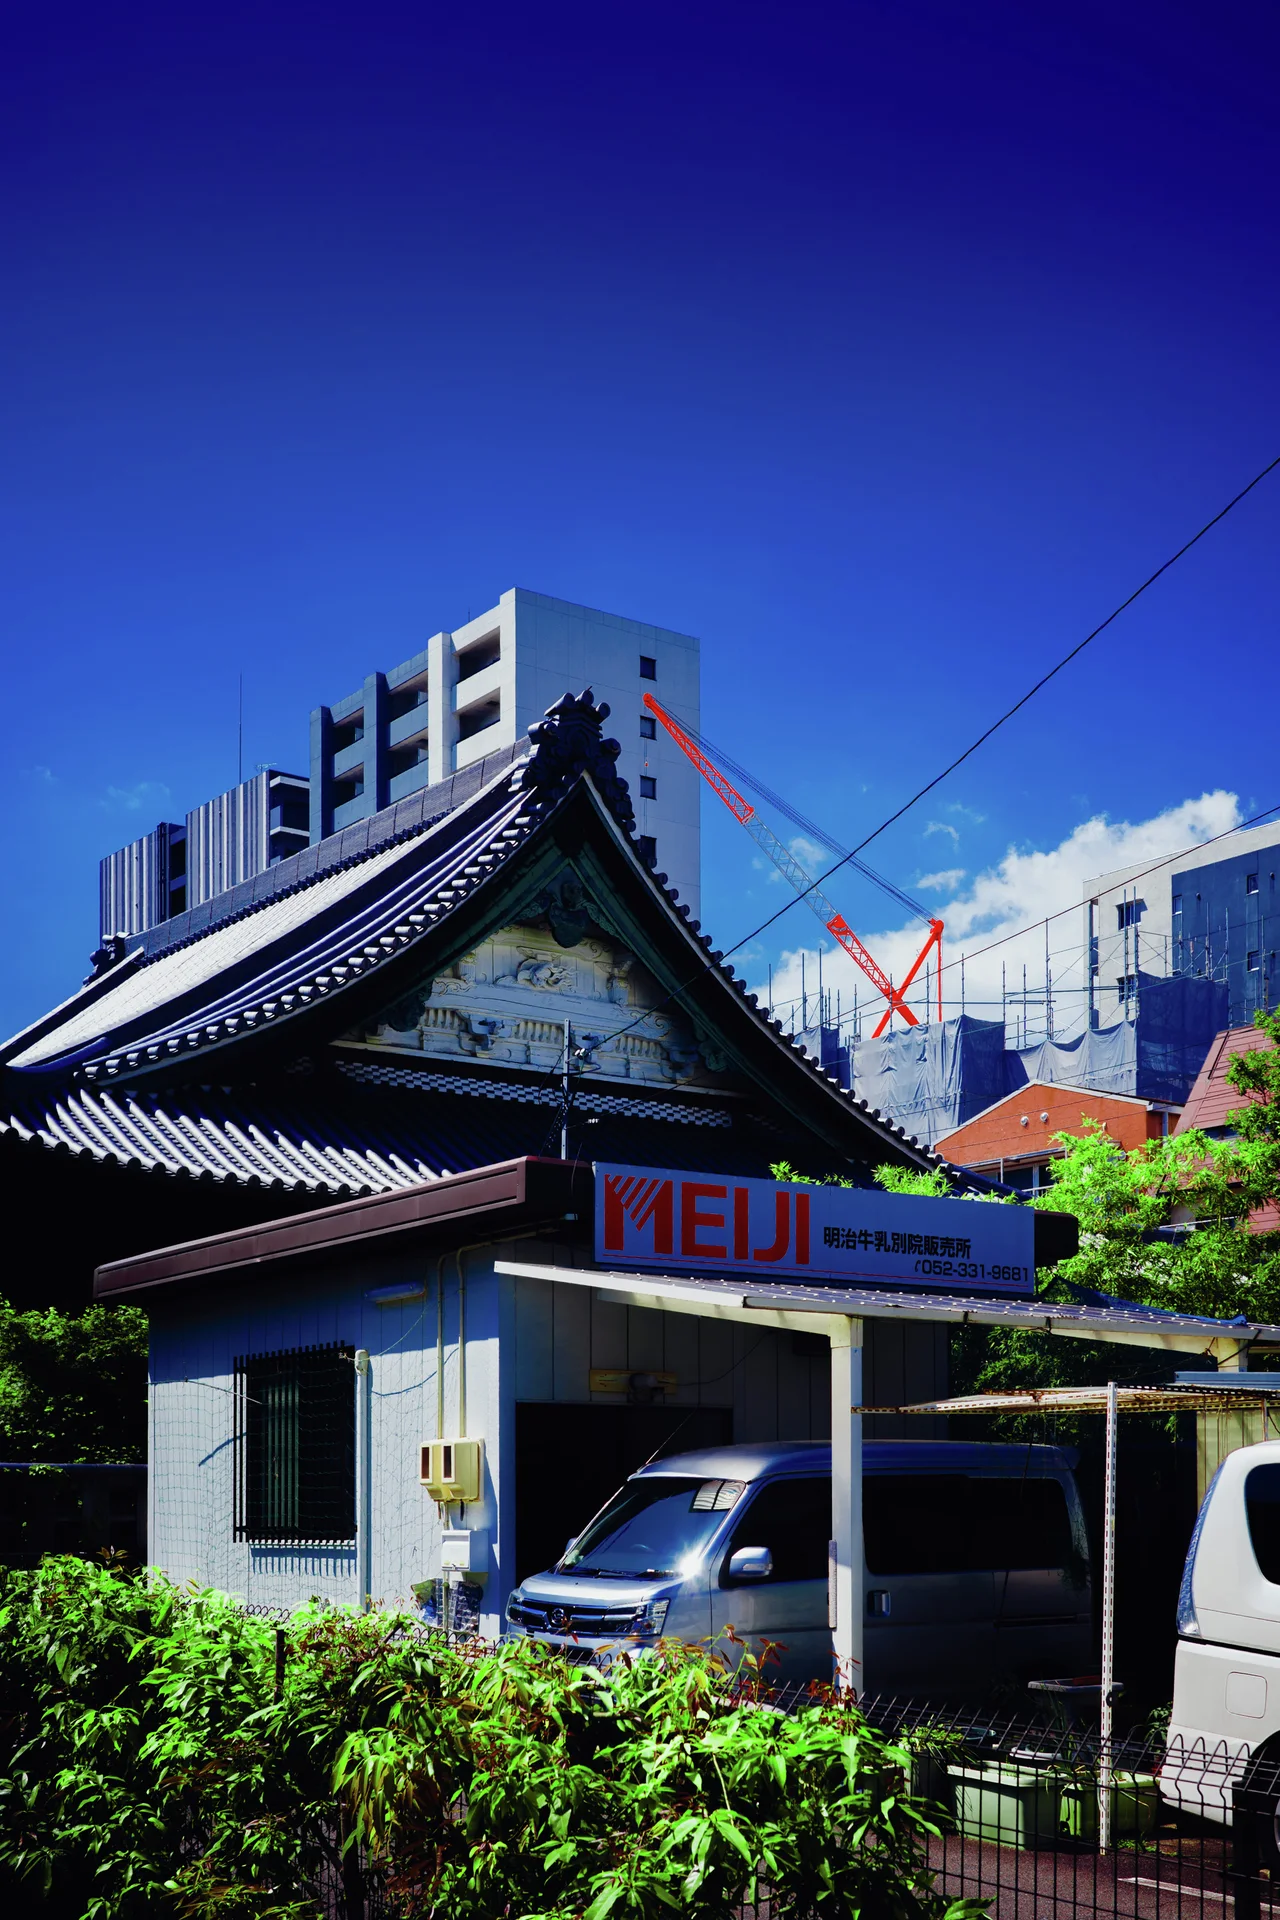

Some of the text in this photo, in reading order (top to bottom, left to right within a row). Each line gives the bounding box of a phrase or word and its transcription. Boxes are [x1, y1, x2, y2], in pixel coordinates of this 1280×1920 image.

[604, 1174, 810, 1265] MEIJI
[823, 1227, 971, 1259] 明治牛乳別院販売所
[921, 1259, 1029, 1282] 052-331-9681
